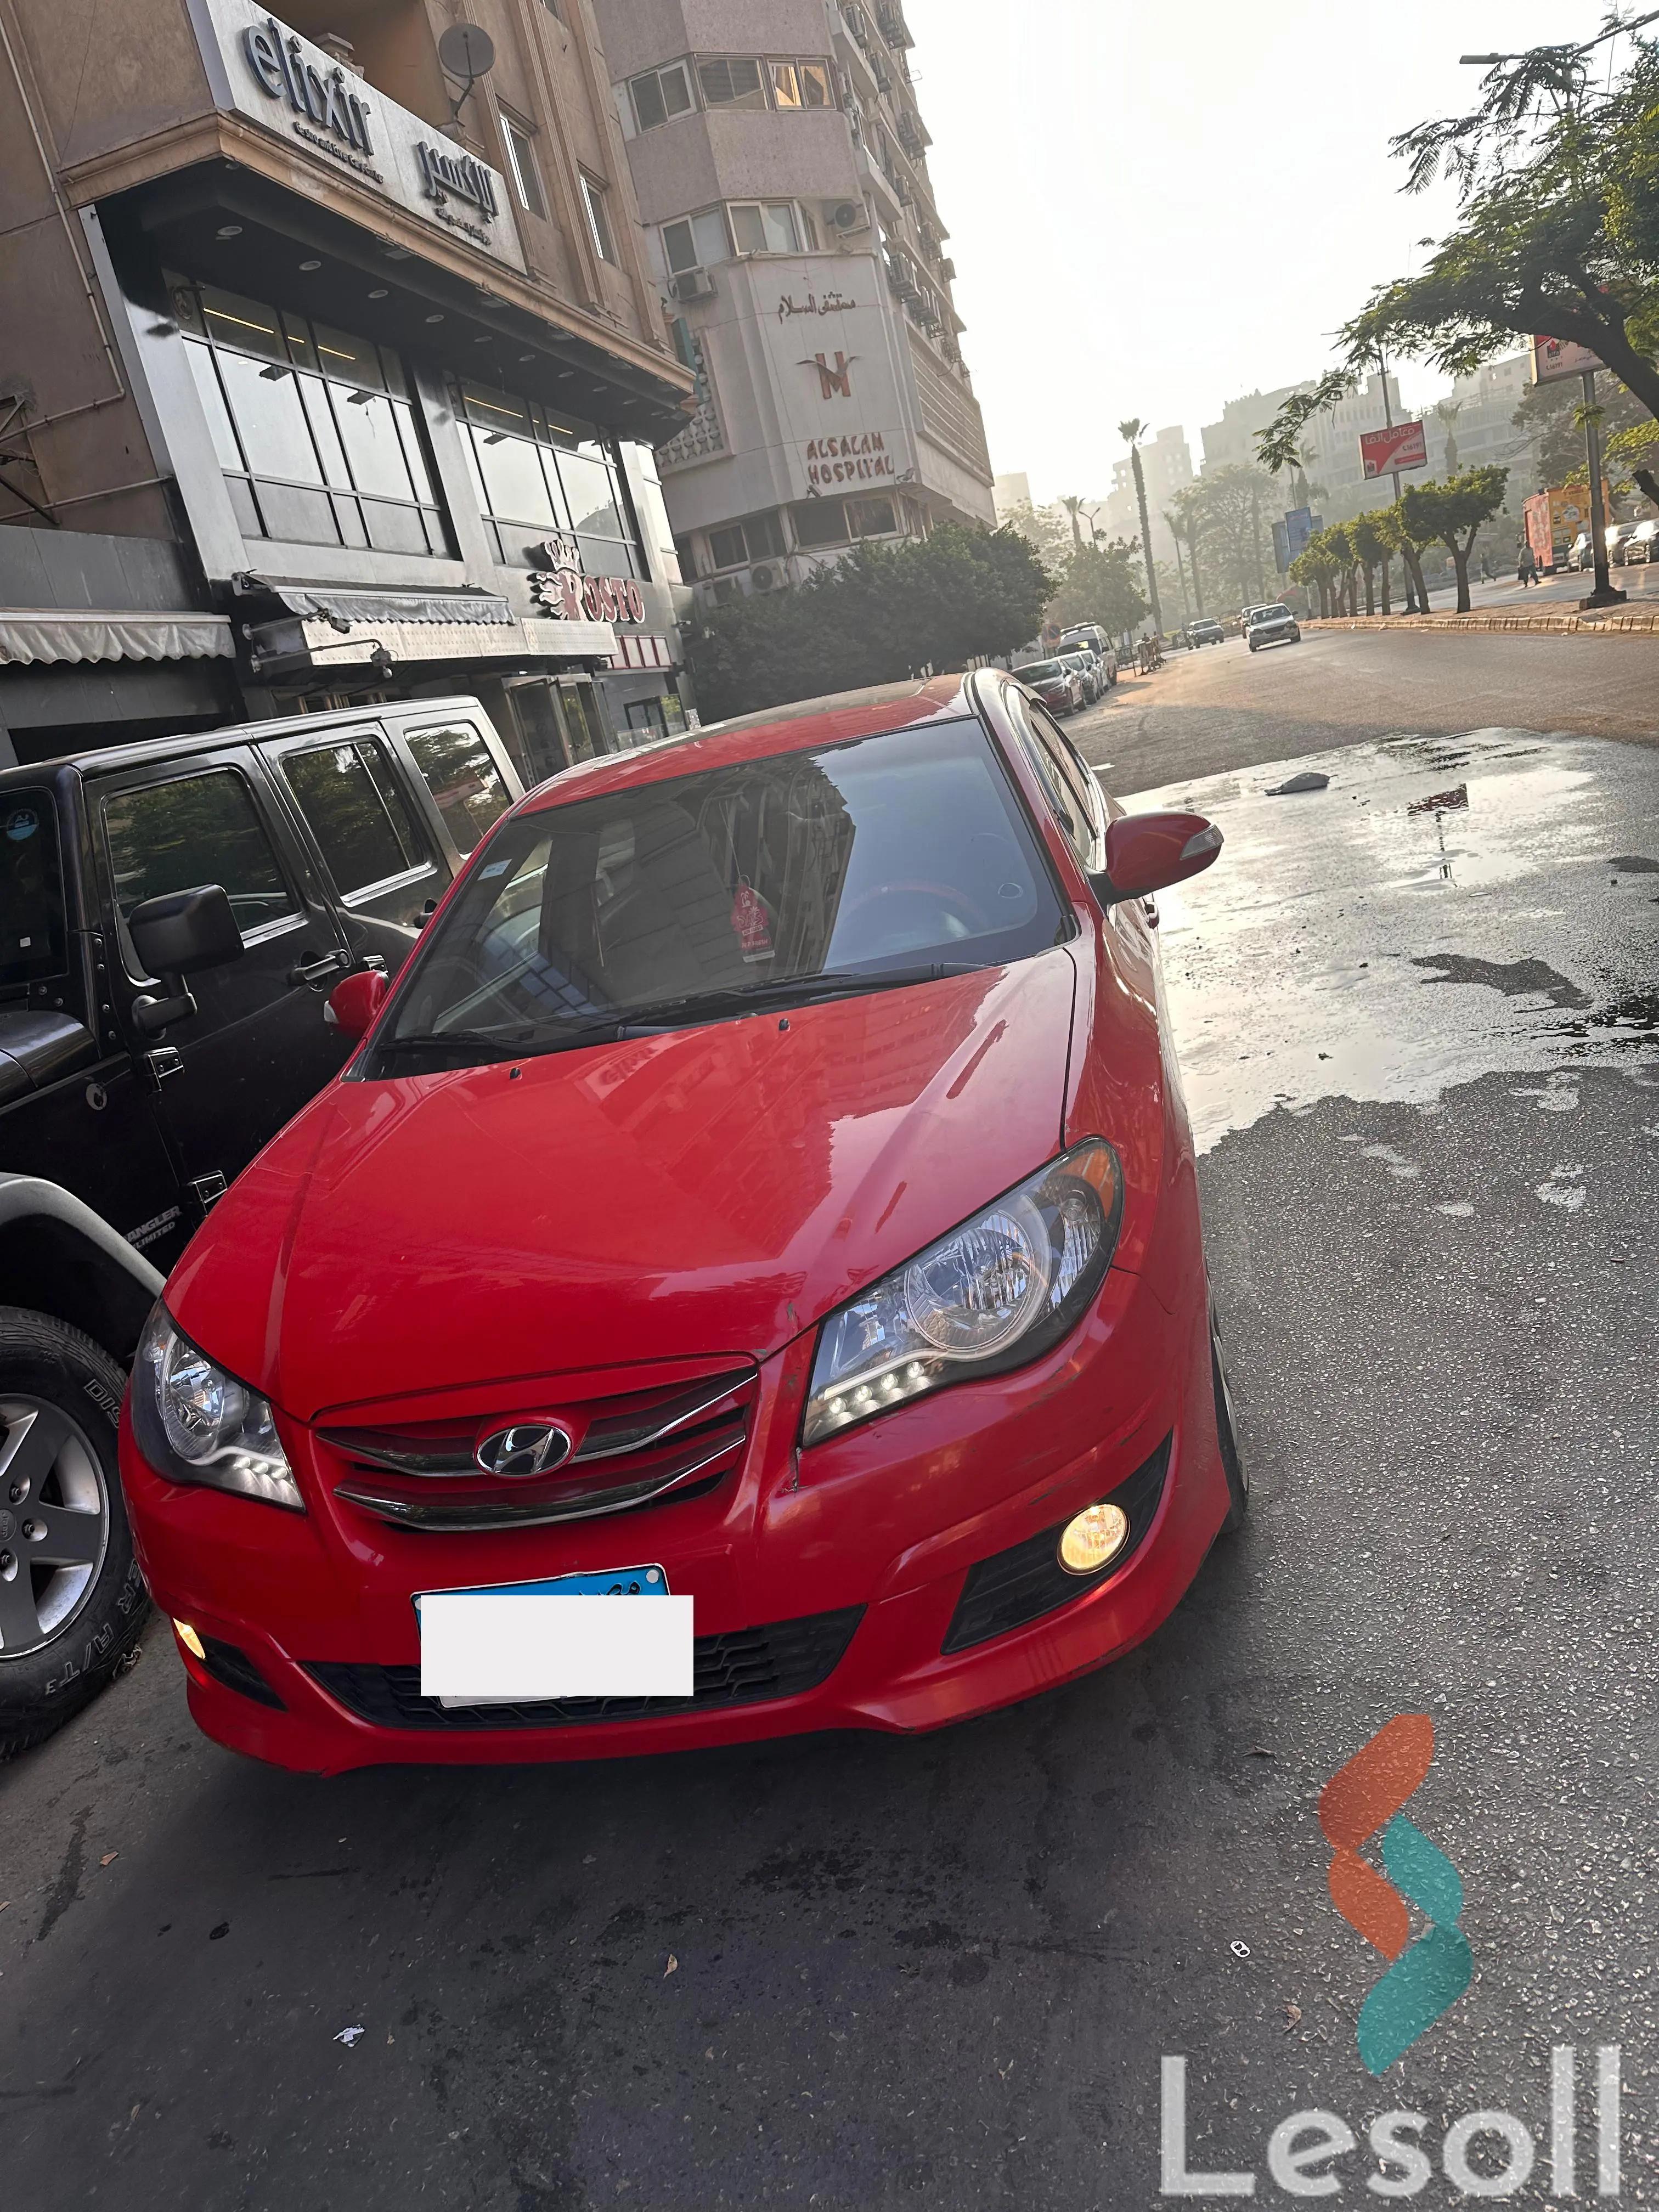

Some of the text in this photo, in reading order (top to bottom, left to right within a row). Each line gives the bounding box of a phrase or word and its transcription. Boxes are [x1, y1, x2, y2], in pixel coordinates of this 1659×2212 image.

[243, 18, 375, 156] elixir
[778, 291, 856, 325] مستشفى السلام
[807, 432, 884, 460] ALSALAM
[808, 455, 895, 485] HOSPITAL
